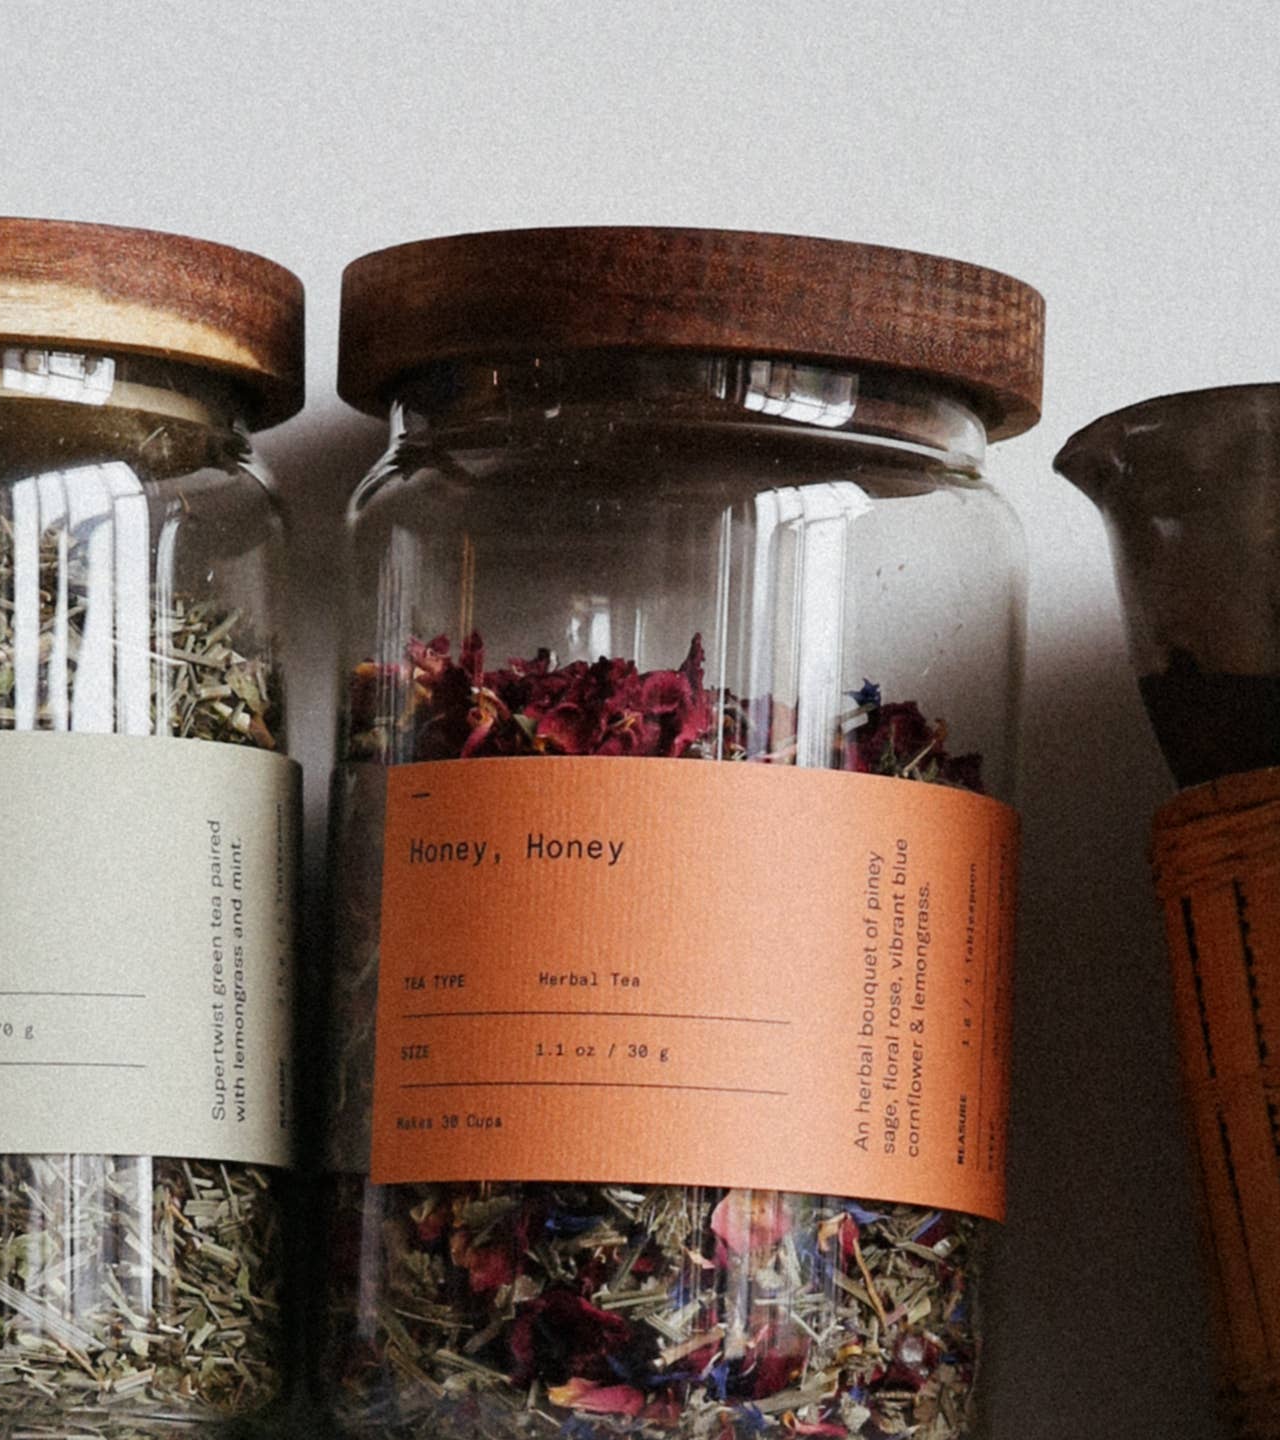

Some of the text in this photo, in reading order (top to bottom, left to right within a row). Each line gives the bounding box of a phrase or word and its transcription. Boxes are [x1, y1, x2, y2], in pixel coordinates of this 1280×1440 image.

[409, 833, 624, 866] Honey, Honey
[24, 1024, 34, 1040] g
[208, 820, 226, 1121] Supertwist green tea paired
[230, 837, 247, 1123] with lemongrass and mint.
[434, 974, 466, 988] TYPE
[539, 971, 599, 987] Herbal
[611, 972, 641, 987] Tea
[854, 851, 885, 1152] An herbal bouquet of piney
[882, 838, 908, 1155] sage, floral rose, vibrant blue
[907, 881, 931, 1158] cornflower & lemongrass.
[400, 1044, 430, 1060] SIZE
[535, 1043, 565, 1058] 1.1
[575, 1045, 596, 1058] oz
[627, 1044, 649, 1058] 30
[659, 1046, 670, 1062] g
[440, 1114, 459, 1129] 30
[466, 1113, 503, 1129] Cups
